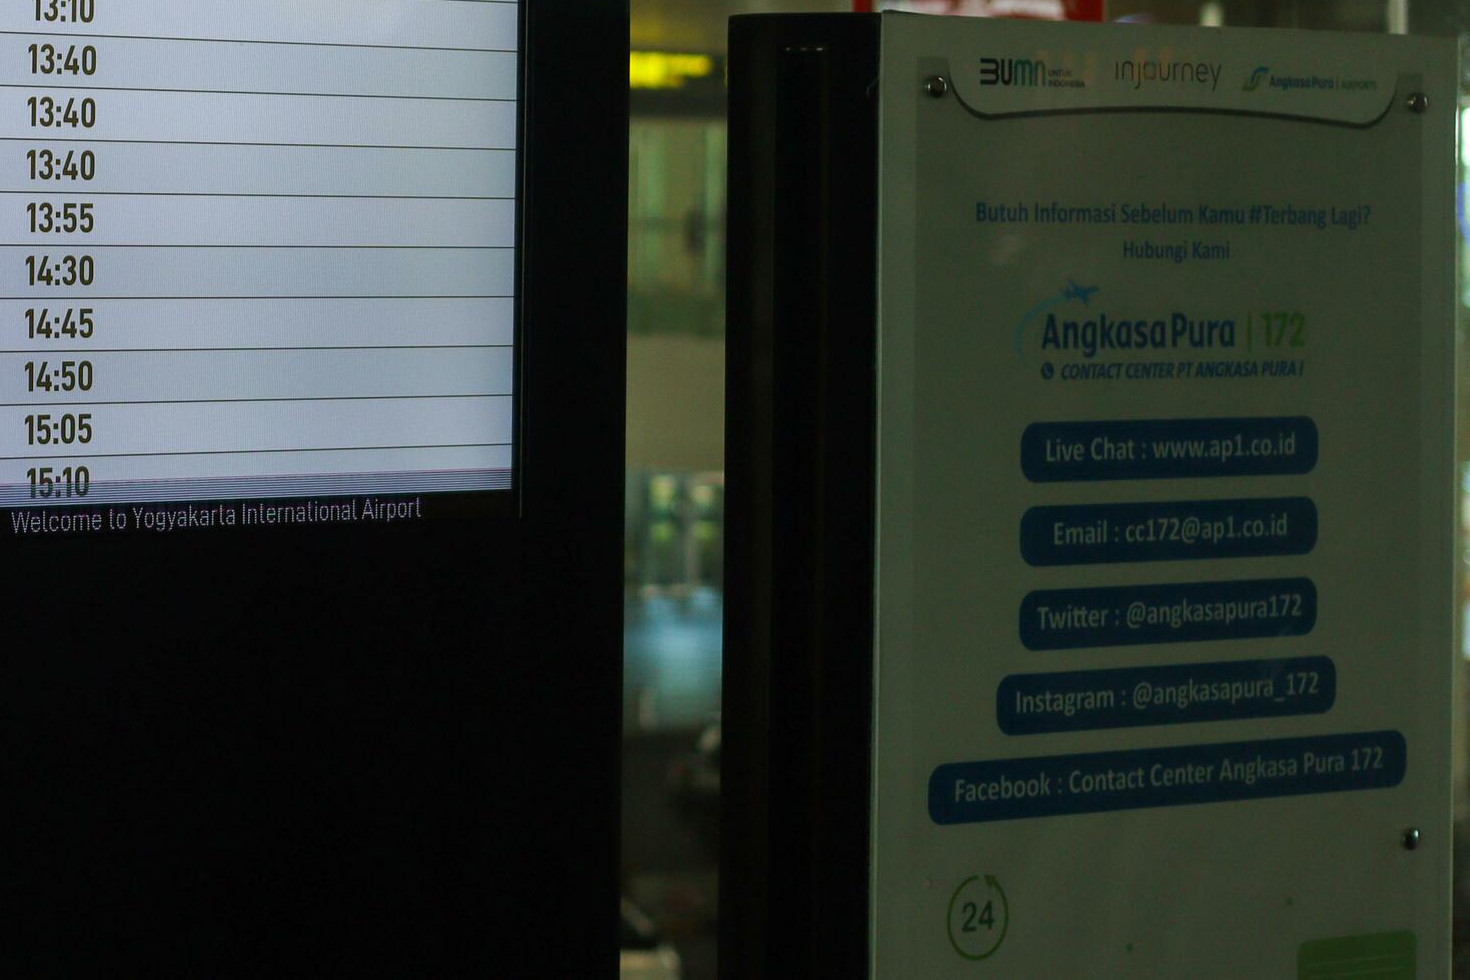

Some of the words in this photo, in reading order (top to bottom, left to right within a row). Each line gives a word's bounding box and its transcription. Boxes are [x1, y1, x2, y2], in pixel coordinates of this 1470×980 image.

[28, 43, 97, 76] 13:40
[27, 96, 96, 129] 13:40
[26, 149, 96, 181] 13:40
[26, 202, 94, 234] 13:55
[976, 202, 1028, 223] Butuh
[1034, 202, 1116, 223] Informasi
[1120, 202, 1193, 225] Sebelum
[1198, 204, 1245, 224] Kamu
[1249, 205, 1327, 228] #Terbang
[1331, 208, 1371, 228] Lagi?
[1123, 240, 1188, 263] Hubungi
[1192, 241, 1230, 260] Kami
[25, 255, 94, 286] 14:30
[24, 308, 94, 339] 14:45
[1261, 313, 1305, 348] 172
[24, 360, 93, 392] 14:50
[1060, 362, 1122, 380] CONTACT
[1125, 362, 1174, 380] CENTER
[1176, 362, 1193, 379] PT
[1195, 361, 1258, 379] ANGKASA
[1261, 361, 1296, 377] PURA
[24, 413, 93, 446] 15:05
[1045, 439, 1084, 462] Live
[1090, 437, 1135, 460] Chat
[1153, 432, 1296, 462] www.ap1.co.id
[26, 466, 91, 499] 15:10
[11, 510, 102, 533] Welcome
[109, 508, 127, 529] to
[132, 505, 236, 531] Yogyakarta
[241, 501, 358, 525] International
[361, 497, 422, 522] Airport
[1053, 521, 1108, 546] Email
[1125, 513, 1288, 546] cc172@ap1.co.id
[1037, 604, 1109, 630] Twitter
[1126, 594, 1302, 630] @angkasapura172
[1015, 687, 1114, 716] Instagram
[1132, 671, 1319, 711] @angkasapura_172
[954, 773, 1051, 804] Facebook
[1068, 769, 1145, 796] Contact
[1150, 760, 1214, 788] Center
[1219, 755, 1298, 784] Angkasa
[1303, 751, 1345, 774] Pura
[1350, 747, 1383, 771] 172
[961, 901, 995, 933] 24
